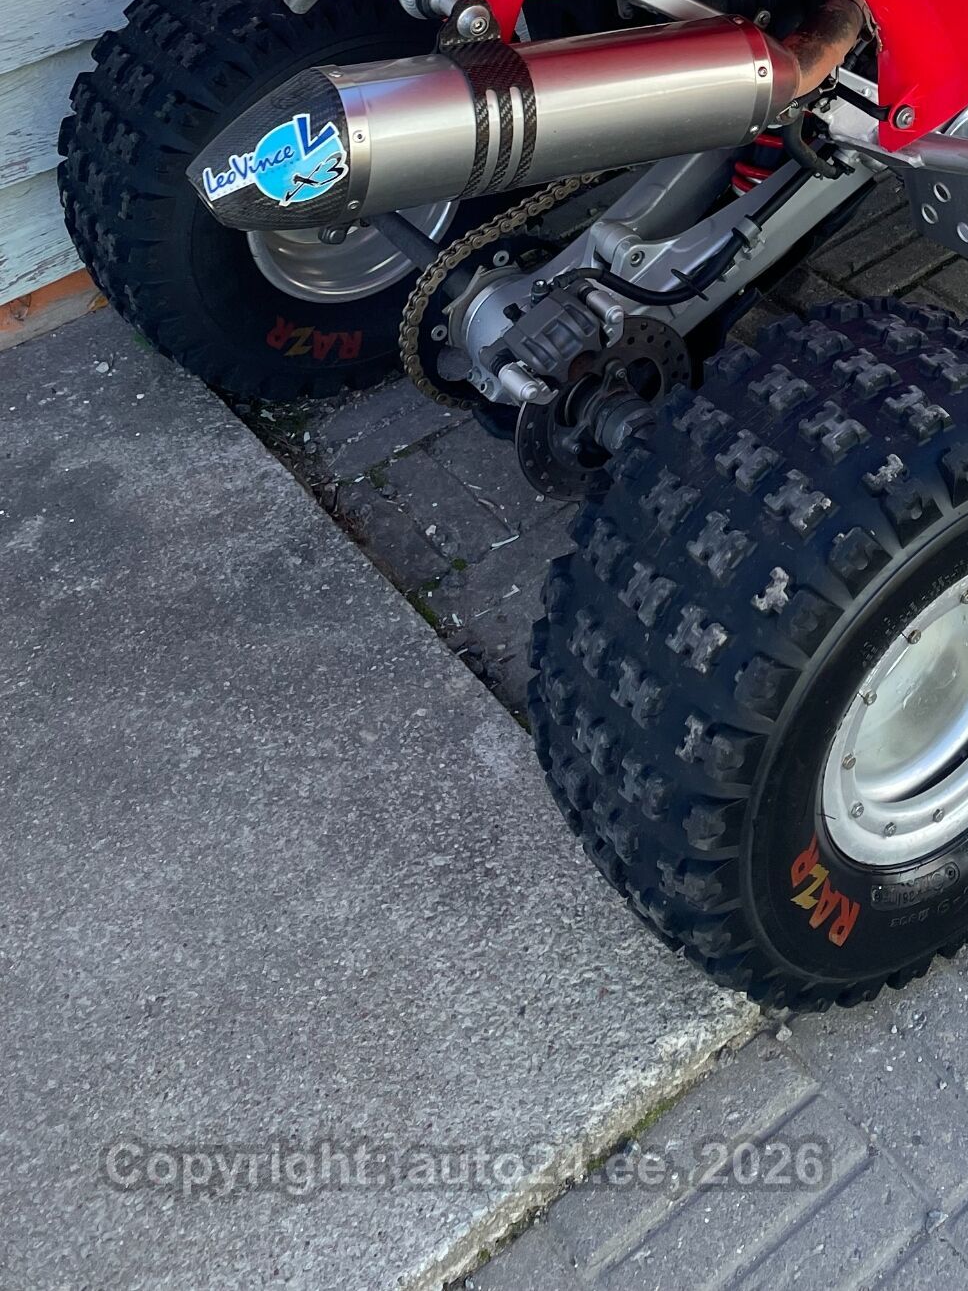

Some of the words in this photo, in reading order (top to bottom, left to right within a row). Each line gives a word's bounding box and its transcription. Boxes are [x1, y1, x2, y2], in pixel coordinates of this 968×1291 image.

[204, 144, 296, 195] LeoVince
[266, 314, 363, 360] RAZR
[790, 831, 861, 947] RAZR
